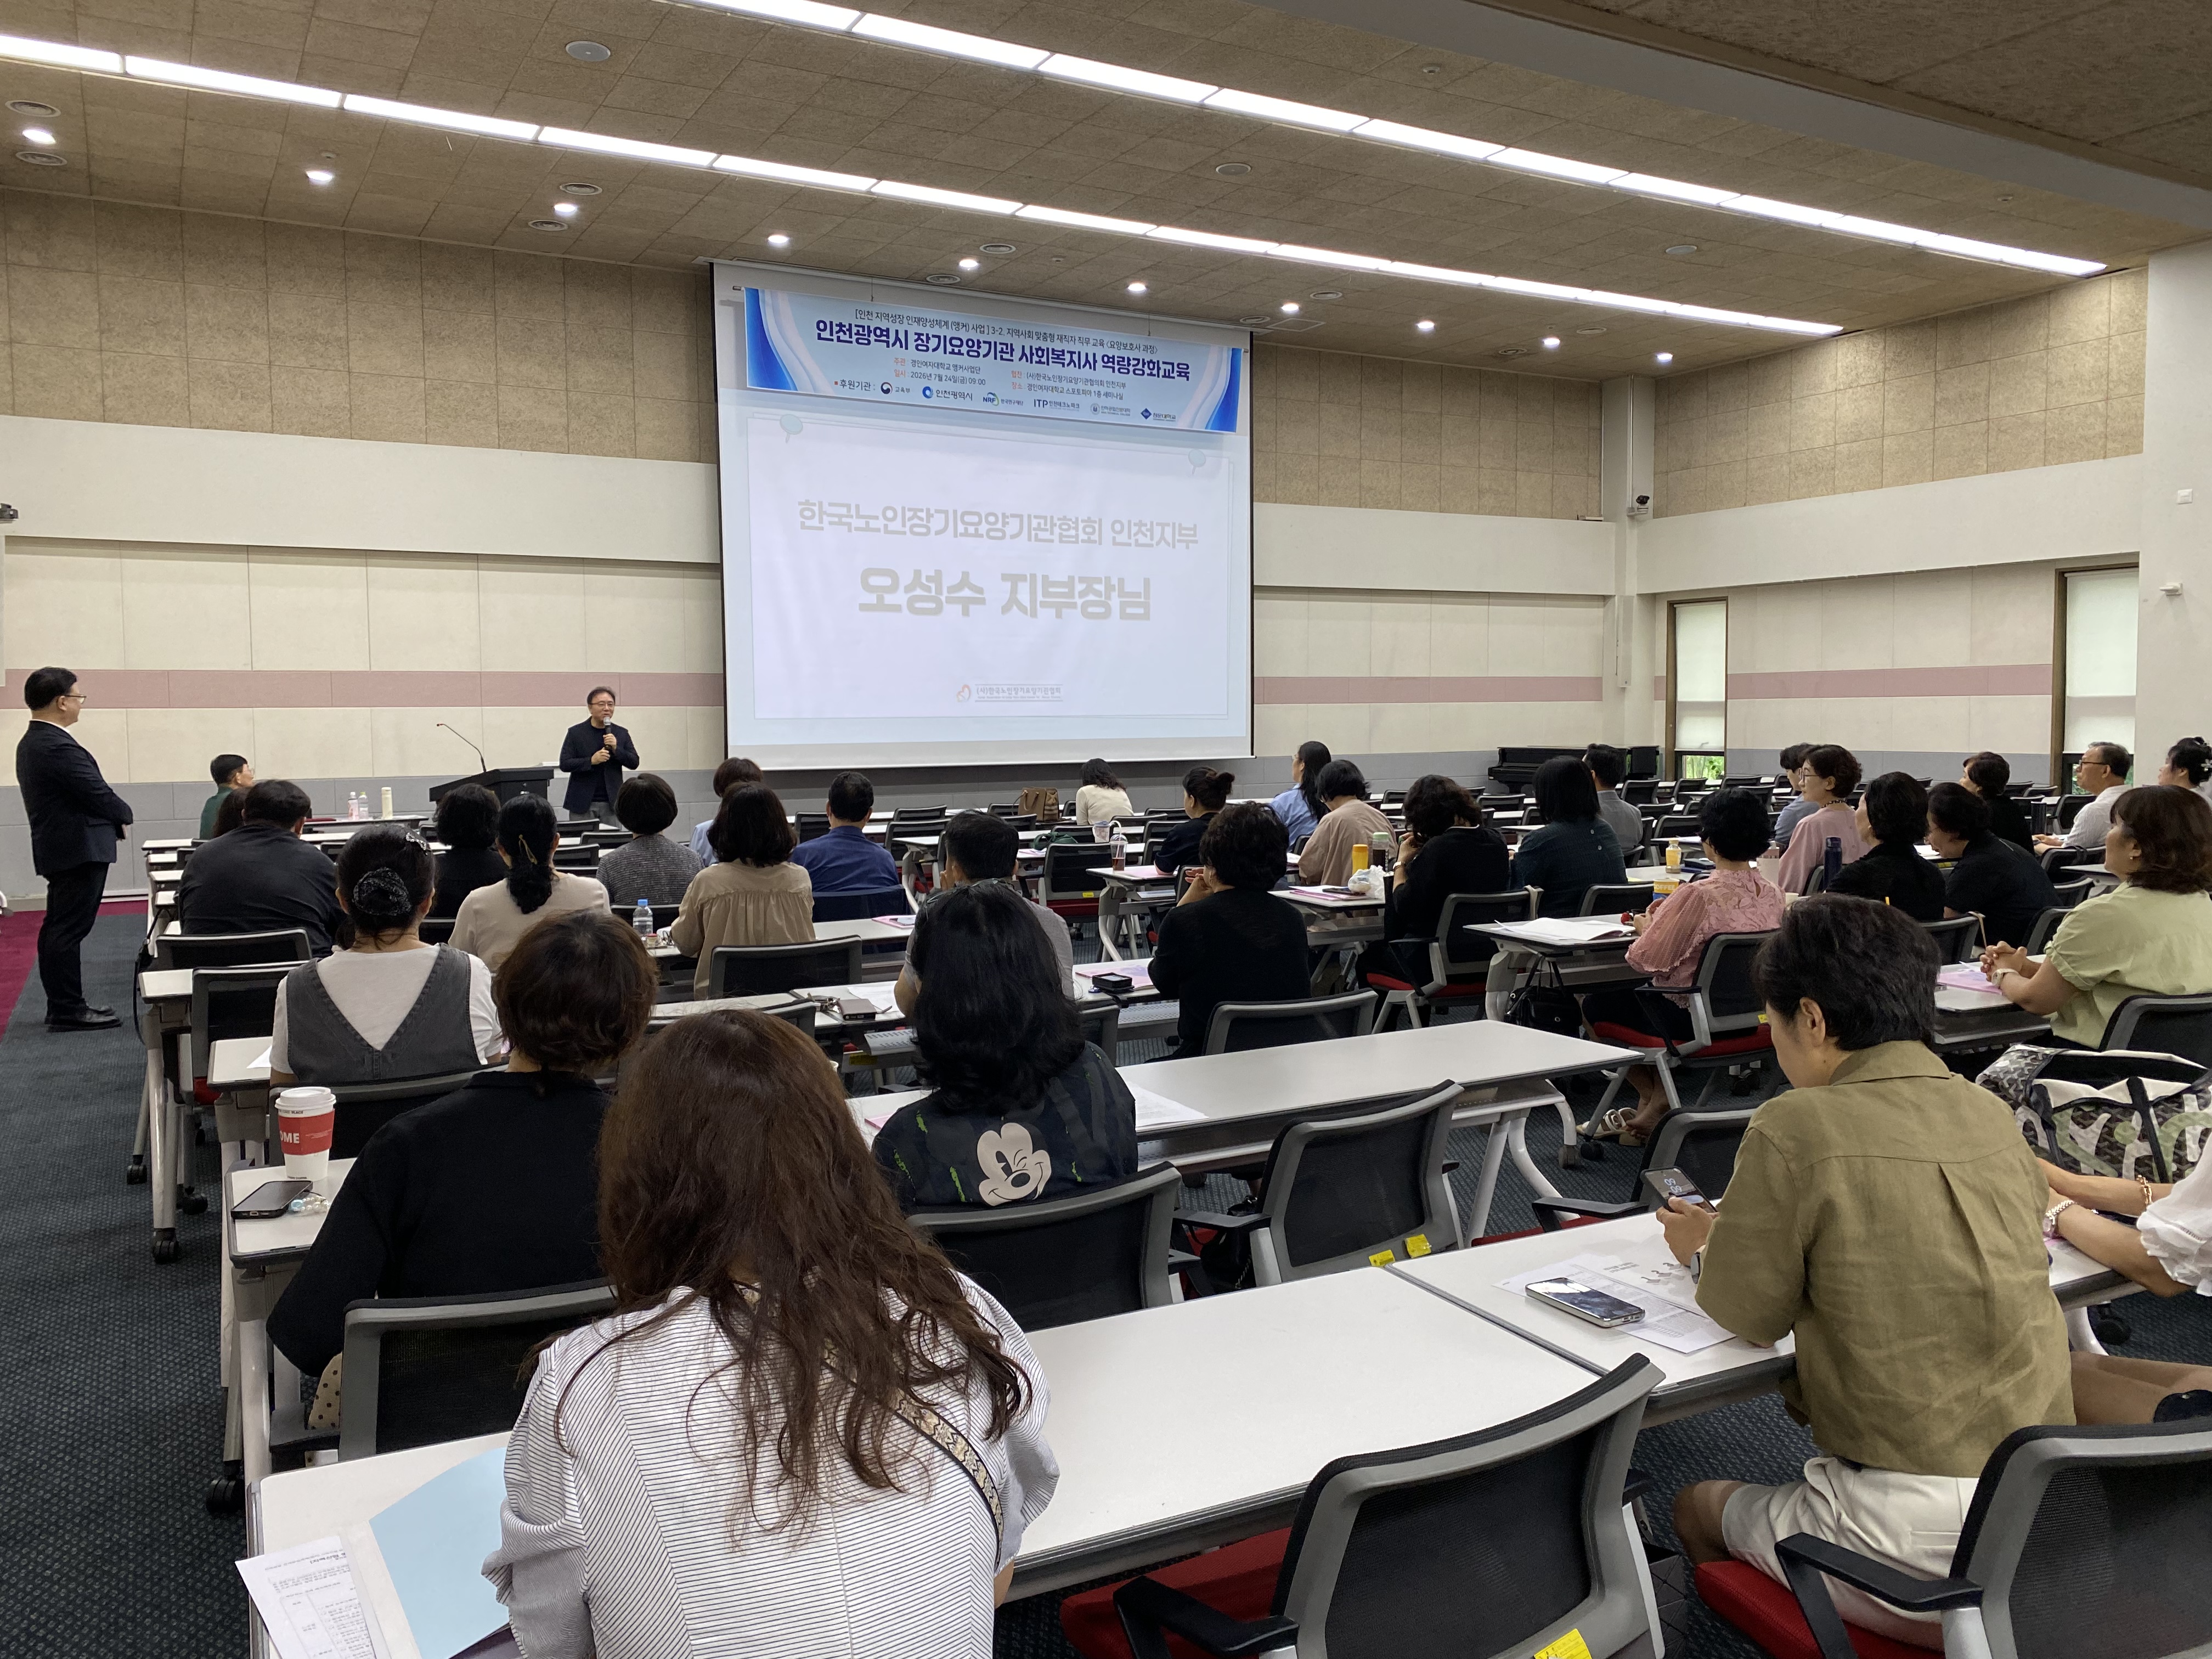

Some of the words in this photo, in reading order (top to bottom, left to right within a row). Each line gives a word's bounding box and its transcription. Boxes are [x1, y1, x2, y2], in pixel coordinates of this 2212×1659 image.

[855, 309, 873, 321] [인천
[875, 312, 904, 325] 지역성장
[906, 315, 949, 330] 인재양성체계
[951, 321, 969, 333] (앵커)
[991, 326, 1006, 336] 3-2.
[1007, 328, 1034, 340] 지역사회
[1035, 331, 1055, 343] 맞춤형
[1056, 334, 1076, 345] 재직자
[1077, 336, 1091, 347] 직무
[1092, 338, 1105, 349] 교육
[816, 319, 909, 351] 인천광역시
[913, 331, 1015, 362] 장기요양기관
[1018, 345, 1098, 371] 사회복지사
[1101, 353, 1190, 381] 역량강화교육
[894, 357, 906, 366] 주관
[910, 359, 951, 371] 경인여자대학교
[952, 364, 981, 375] 앵커사업단
[839, 379, 871, 392] 후원기관
[894, 369, 906, 377] 일시
[910, 371, 932, 380] 2026년
[933, 374, 943, 382] 7월
[944, 375, 967, 385] 24일(금)
[968, 377, 986, 386] 09:00
[1105, 380, 1126, 390] 인천지부
[935, 390, 973, 401] 인천광역시
[1012, 381, 1023, 390] 장소
[1027, 383, 1064, 394] 경인여자대학교
[1065, 387, 1092, 397] 스포토피아
[1093, 390, 1102, 398] 1층
[1103, 391, 1124, 400] 세미나실
[1034, 399, 1048, 408] ITP
[1048, 400, 1080, 409] 인천테크노파크
[798, 499, 1103, 546] 한국노인장기요양기관협회
[1110, 519, 1199, 550] 인천지부
[858, 567, 986, 617] 오성수
[1001, 573, 1150, 621] 지부장님
[1664, 1178, 1676, 1186] 09
